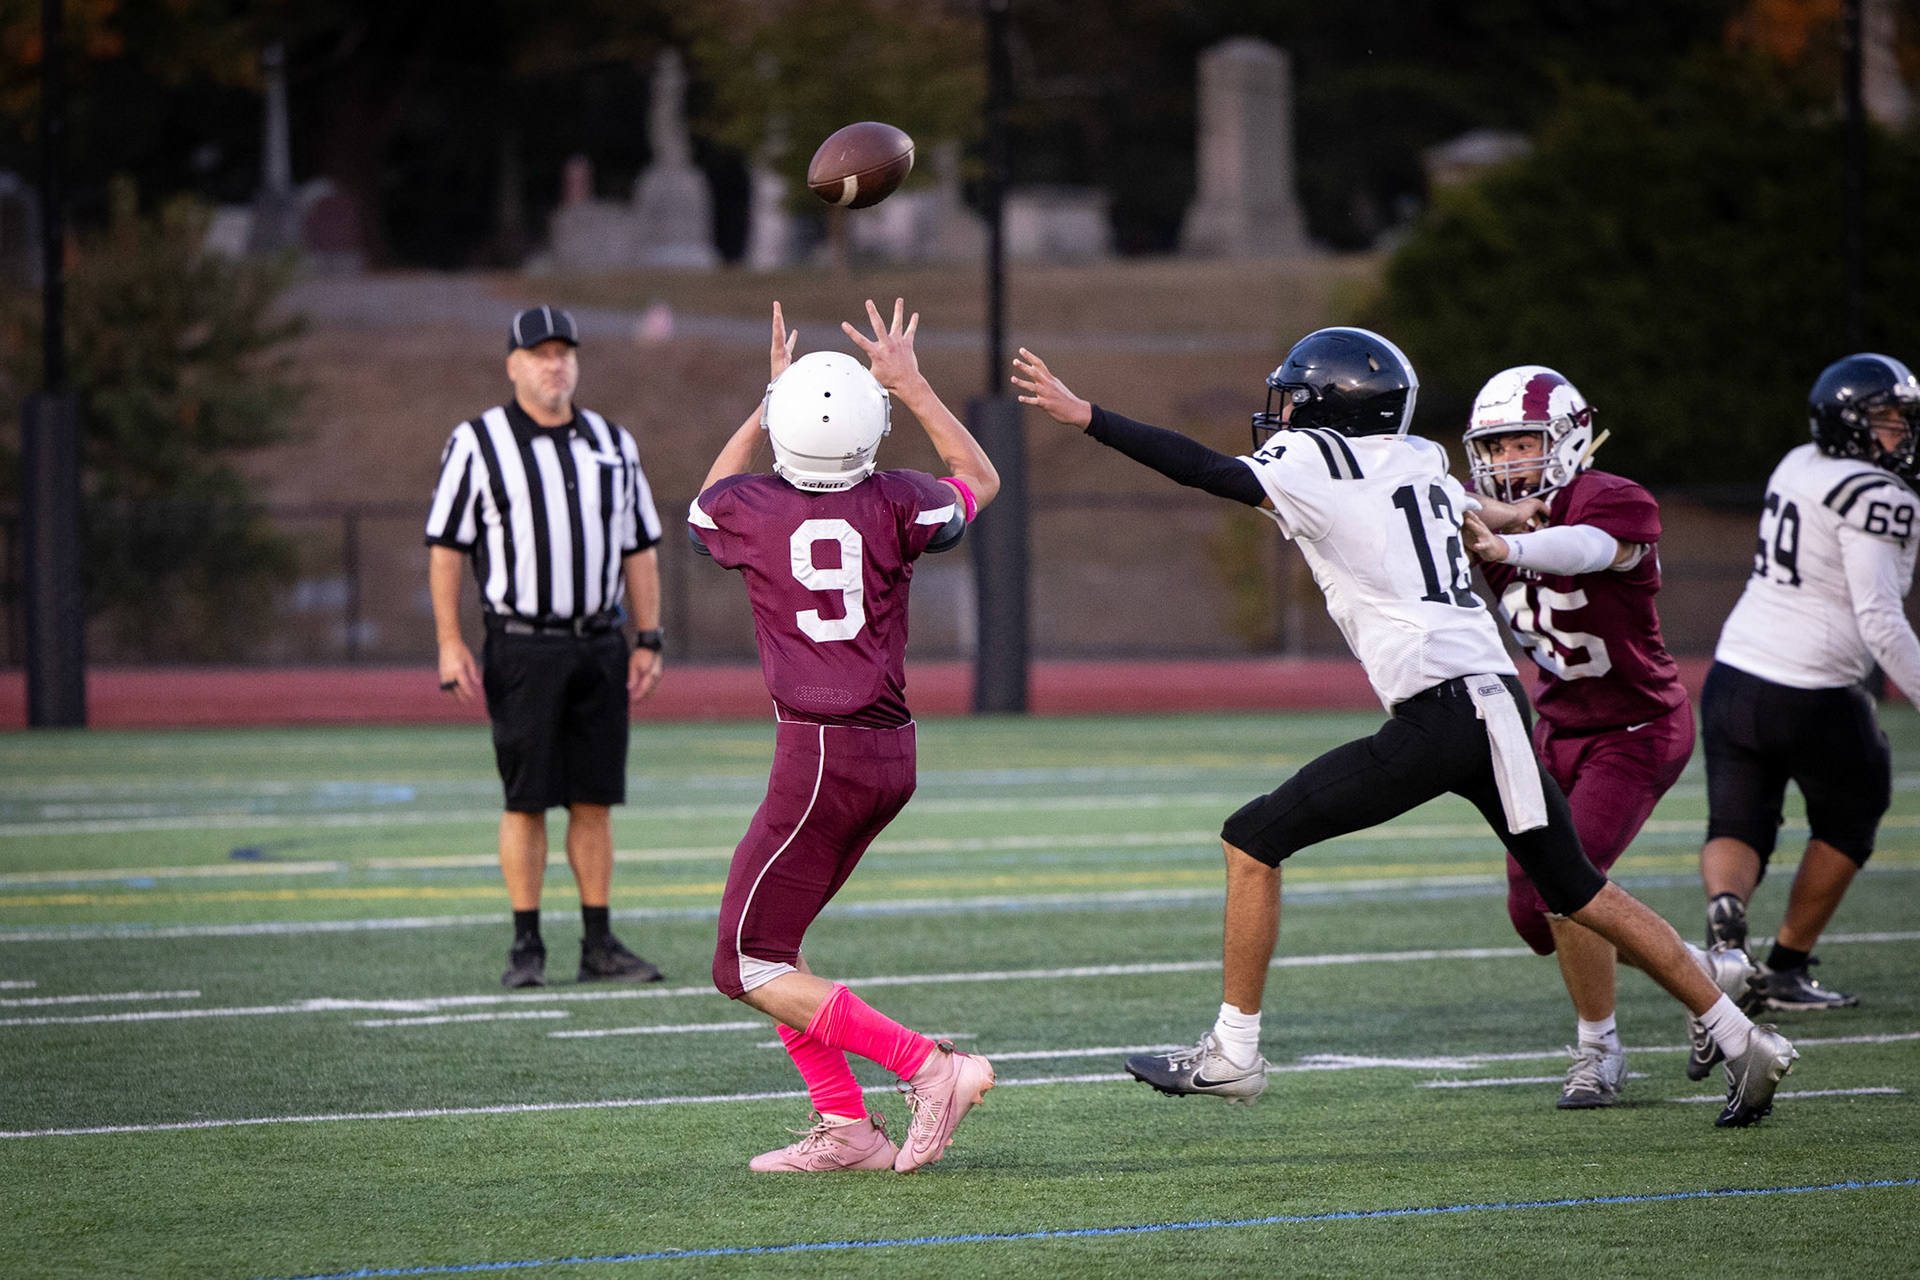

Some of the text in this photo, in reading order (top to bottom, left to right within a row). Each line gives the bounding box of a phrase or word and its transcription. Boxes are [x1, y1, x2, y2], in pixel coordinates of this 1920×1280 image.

[801, 481, 845, 489] schutt
[1864, 502, 1914, 539] 69
[790, 519, 866, 643] 9
[1391, 484, 1480, 608] 12
